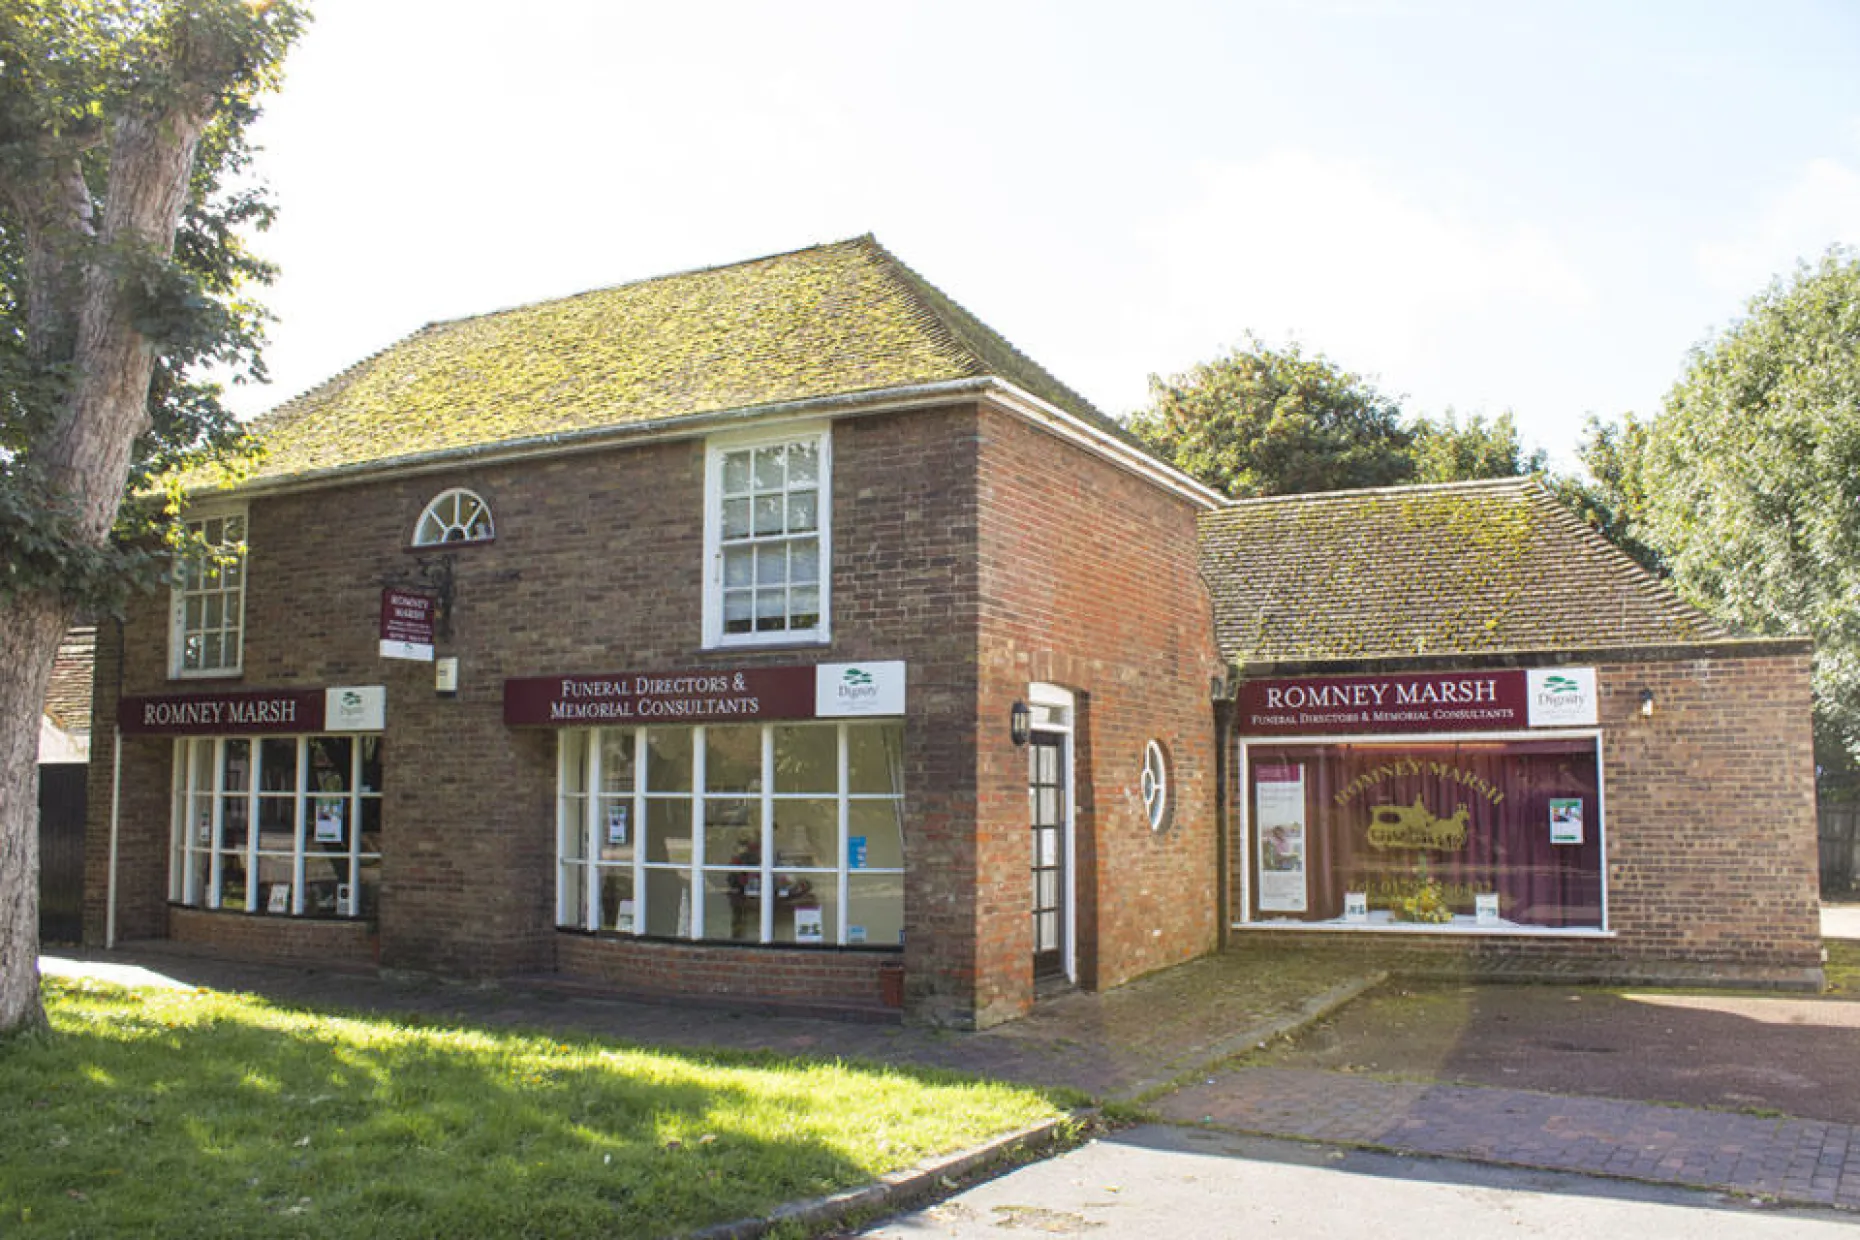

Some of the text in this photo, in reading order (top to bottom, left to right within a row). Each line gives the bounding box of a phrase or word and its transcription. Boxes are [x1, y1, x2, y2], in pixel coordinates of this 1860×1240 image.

[732, 672, 747, 691] &
[1267, 679, 1497, 708] ROMNEY MARSH
[1537, 693, 1587, 709] Dignity
[143, 700, 296, 725] ROMNEY MARSH
[1362, 711, 1369, 721] &
[1334, 756, 1423, 806] ROMNEY
[1429, 761, 1505, 805] MARSH
